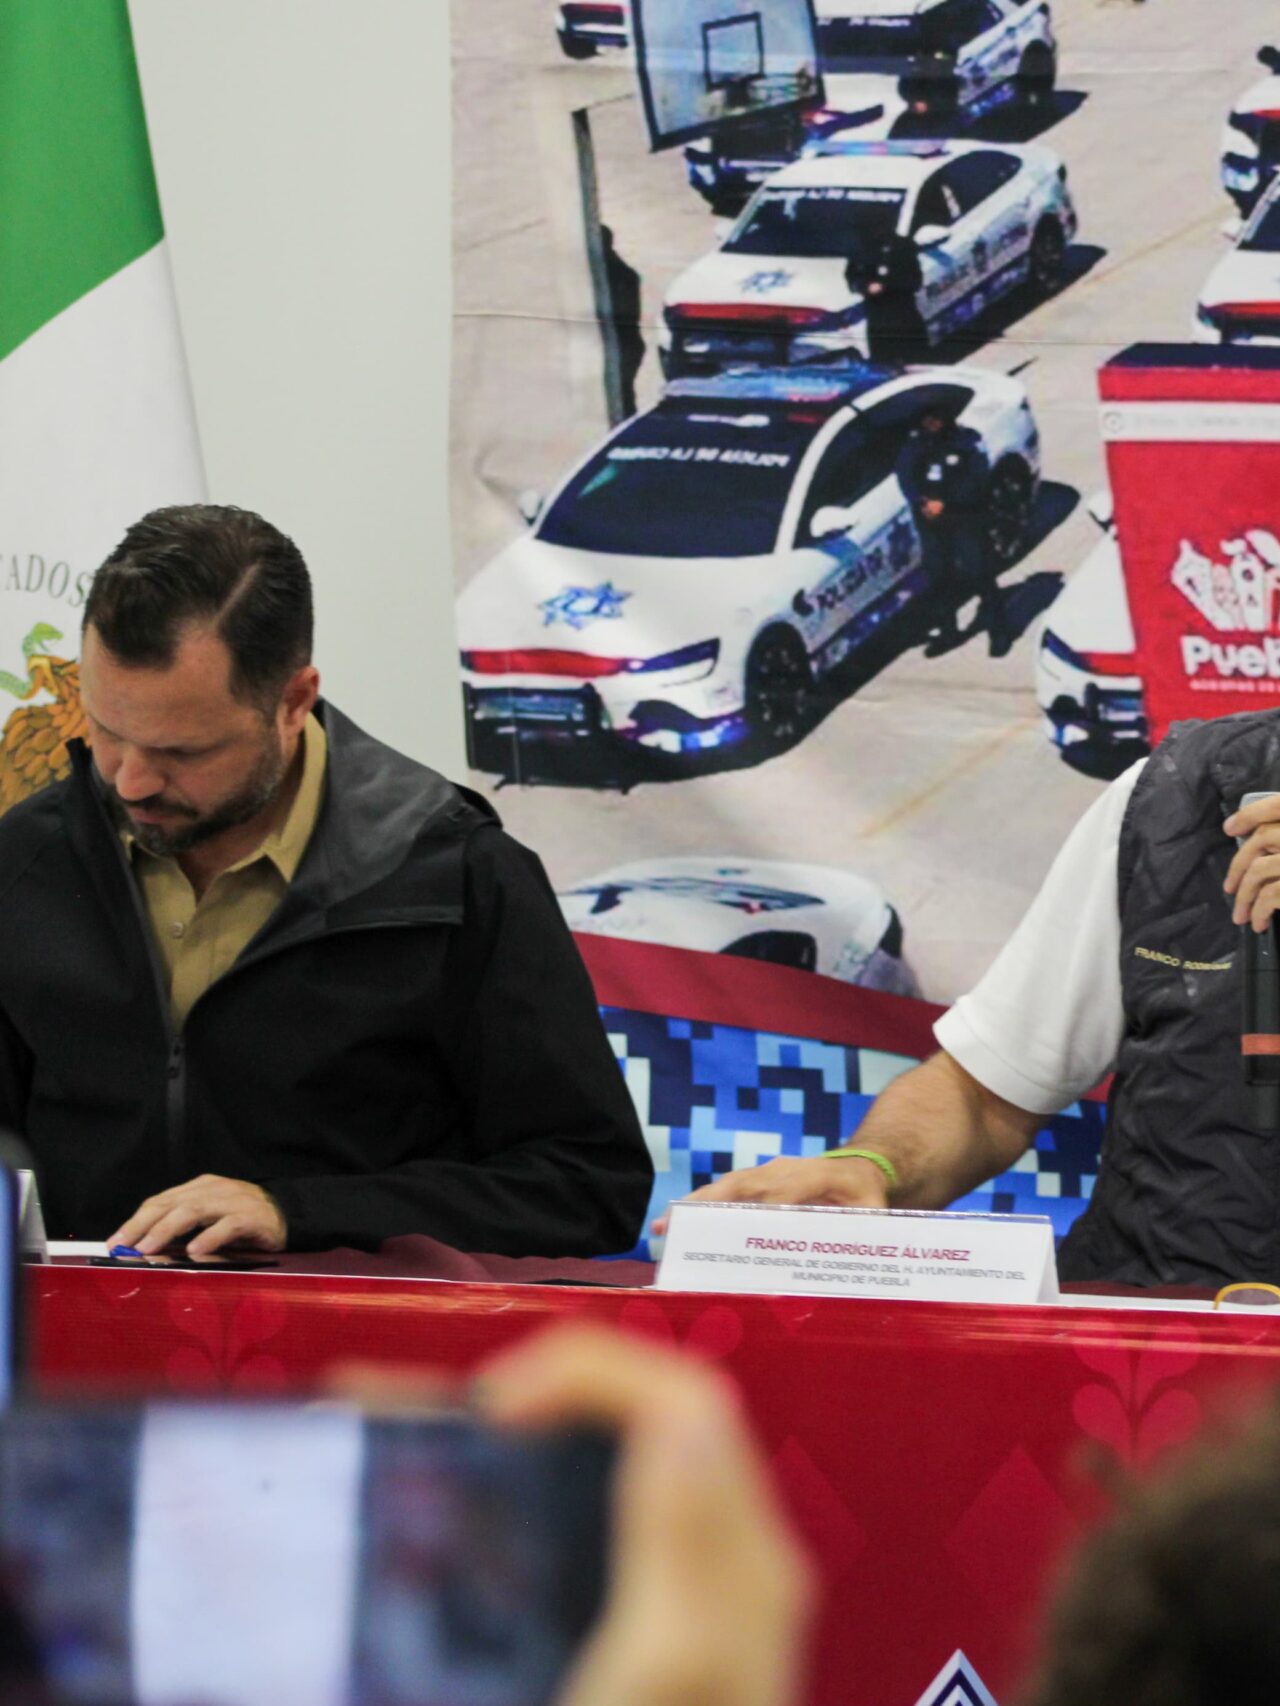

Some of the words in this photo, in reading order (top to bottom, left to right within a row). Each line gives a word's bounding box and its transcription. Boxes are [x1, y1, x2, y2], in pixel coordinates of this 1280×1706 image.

[0, 553, 95, 608] ADOS
[745, 1237, 808, 1252] FRANCO
[811, 1241, 899, 1258] RODRÍGUEZ
[901, 1244, 971, 1261] ÁLVAREZ
[682, 1251, 751, 1264] SECRETARIO
[752, 1256, 803, 1267] GENERAL
[805, 1259, 820, 1269] DE
[821, 1260, 880, 1272] GOBIERNO
[881, 1264, 900, 1274] DEL
[1005, 1270, 1027, 1281] DEL
[792, 1271, 849, 1284] MUNICIPIO
[851, 1274, 866, 1285] DE
[867, 1276, 911, 1287] PUEBLA
